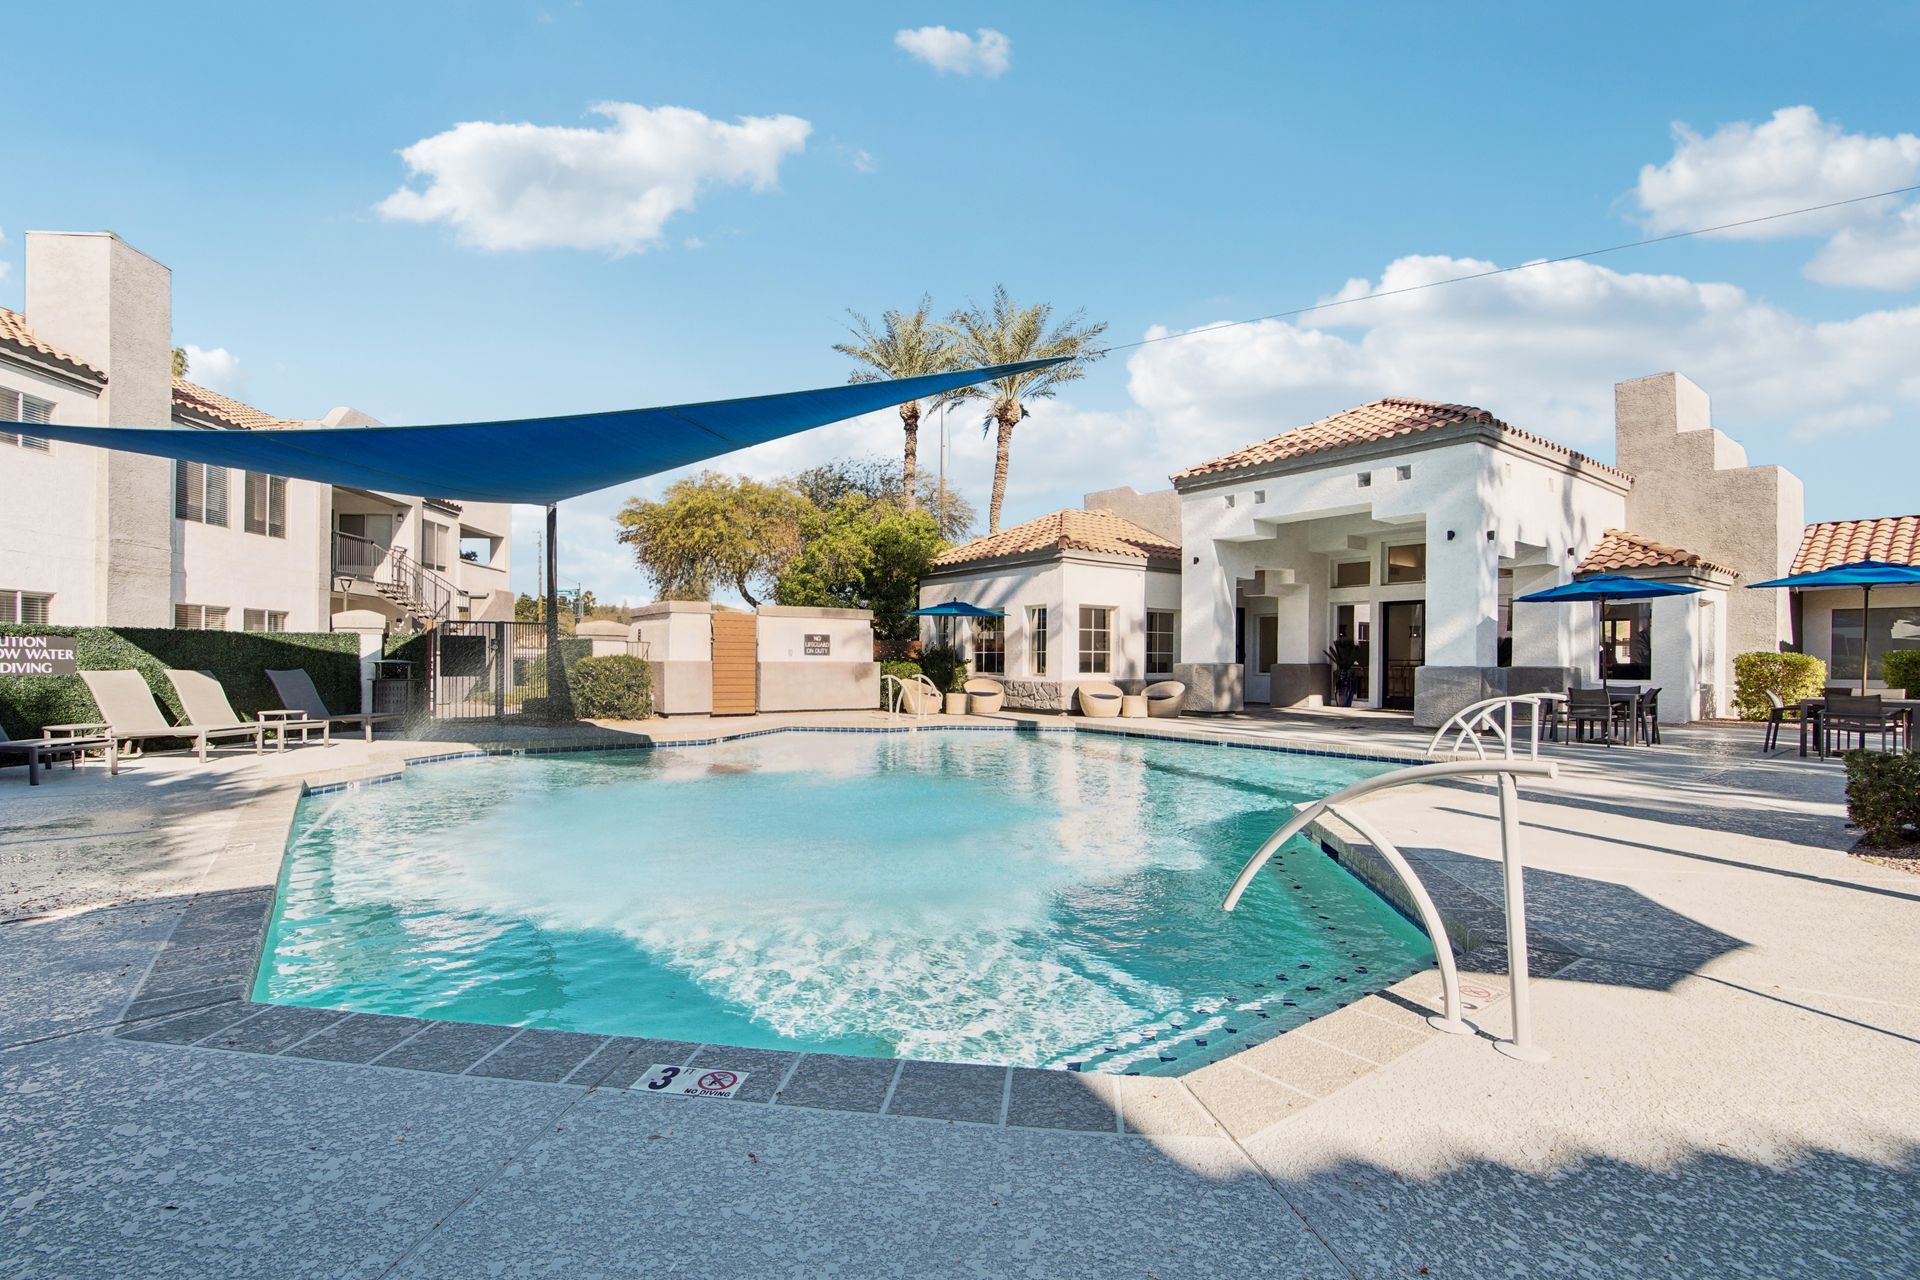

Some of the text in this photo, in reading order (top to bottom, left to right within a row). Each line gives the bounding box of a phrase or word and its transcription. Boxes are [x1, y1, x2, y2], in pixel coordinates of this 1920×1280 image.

[0, 636, 47, 648] UTION
[25, 648, 75, 660] WATER
[0, 662, 53, 674] DIVING
[648, 1066, 681, 1090] 3
[683, 1087, 732, 1098] NO DIVING
